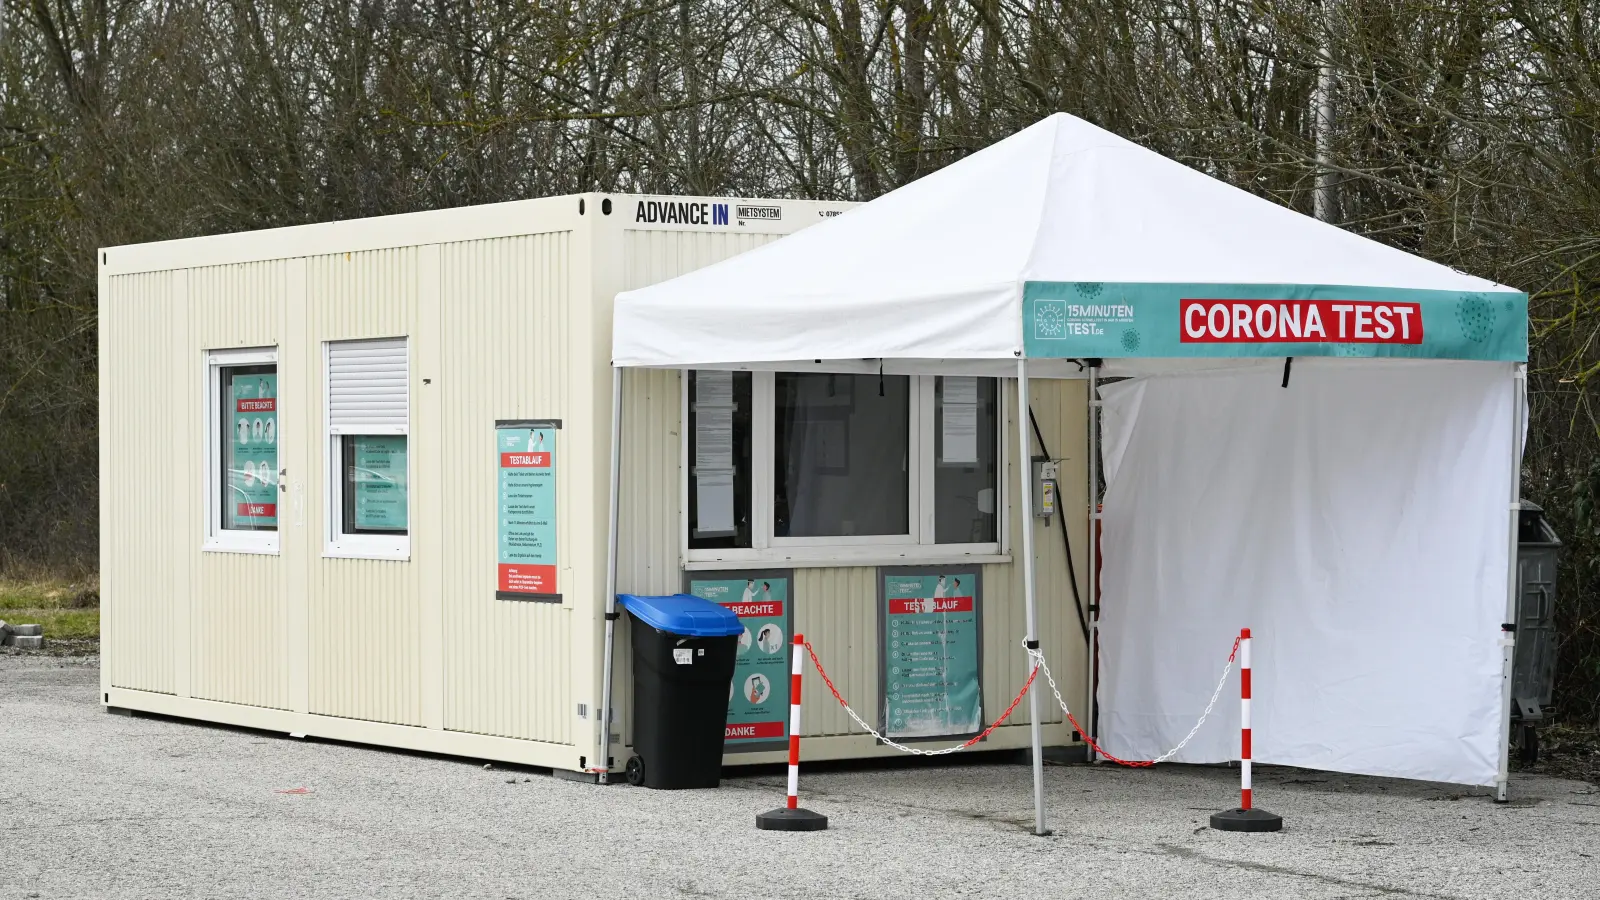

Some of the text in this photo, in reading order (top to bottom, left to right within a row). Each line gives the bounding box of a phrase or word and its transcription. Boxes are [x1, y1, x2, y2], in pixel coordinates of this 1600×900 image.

[635, 201, 729, 225] ADVANCE IN
[738, 206, 780, 218] MIETSYSTEM
[1067, 304, 1134, 317] 15MINUTEN
[1184, 303, 1414, 340] CORONA TEST
[241, 400, 272, 410] BITTE BEACHTE
[509, 455, 543, 465] TESTABLAUF
[732, 604, 774, 615] BEACHTE
[903, 600, 959, 611] TESTBLAUF
[725, 726, 755, 737] DANKE
